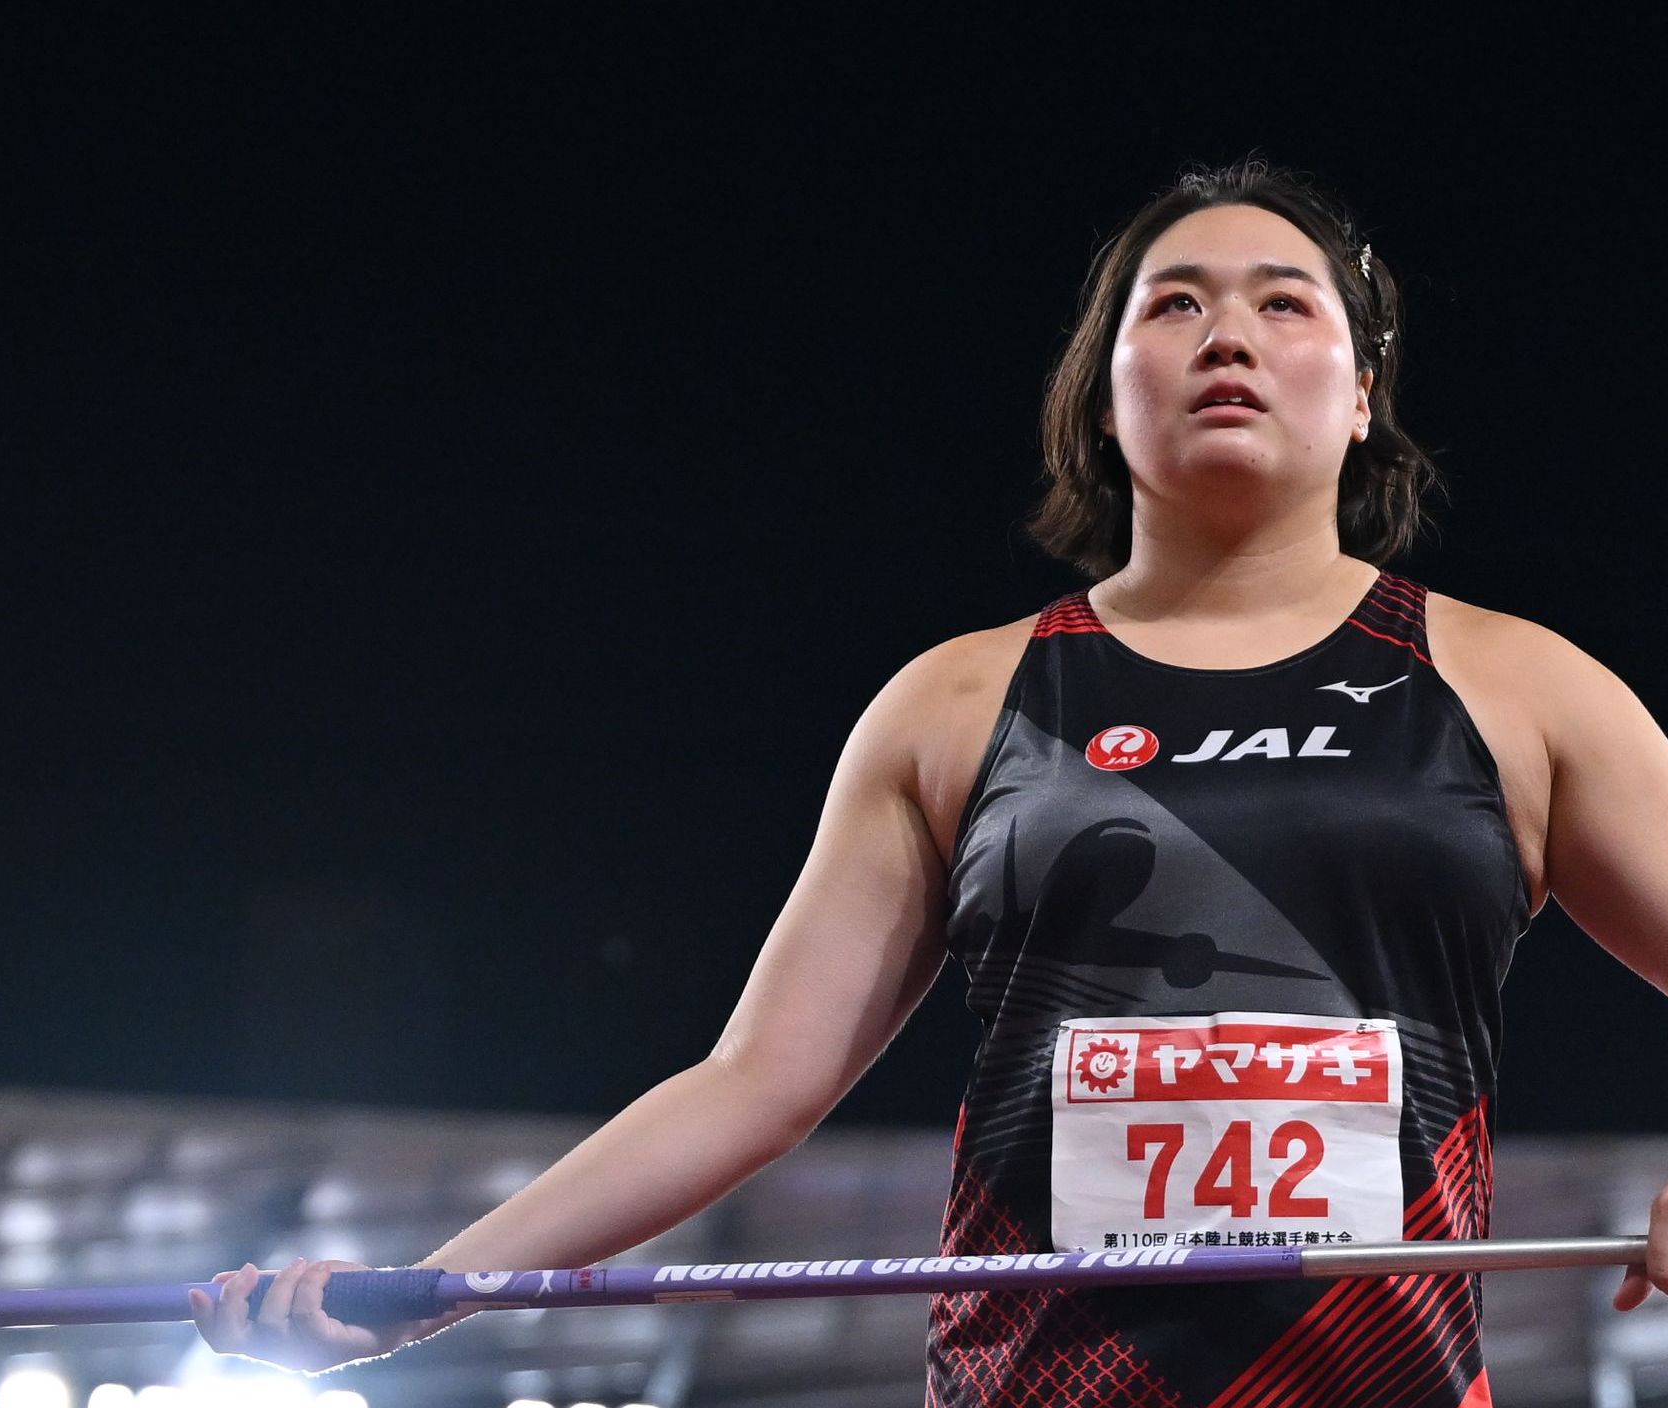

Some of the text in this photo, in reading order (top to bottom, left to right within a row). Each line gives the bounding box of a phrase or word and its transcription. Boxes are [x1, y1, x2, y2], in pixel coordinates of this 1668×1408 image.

[1103, 756, 1142, 766] JAL
[1171, 726, 1352, 763] JAL
[1152, 1042, 1372, 1086] ヤマザキ
[1126, 1120, 1329, 1219] 742
[1104, 1232, 1167, 1249] 第110回
